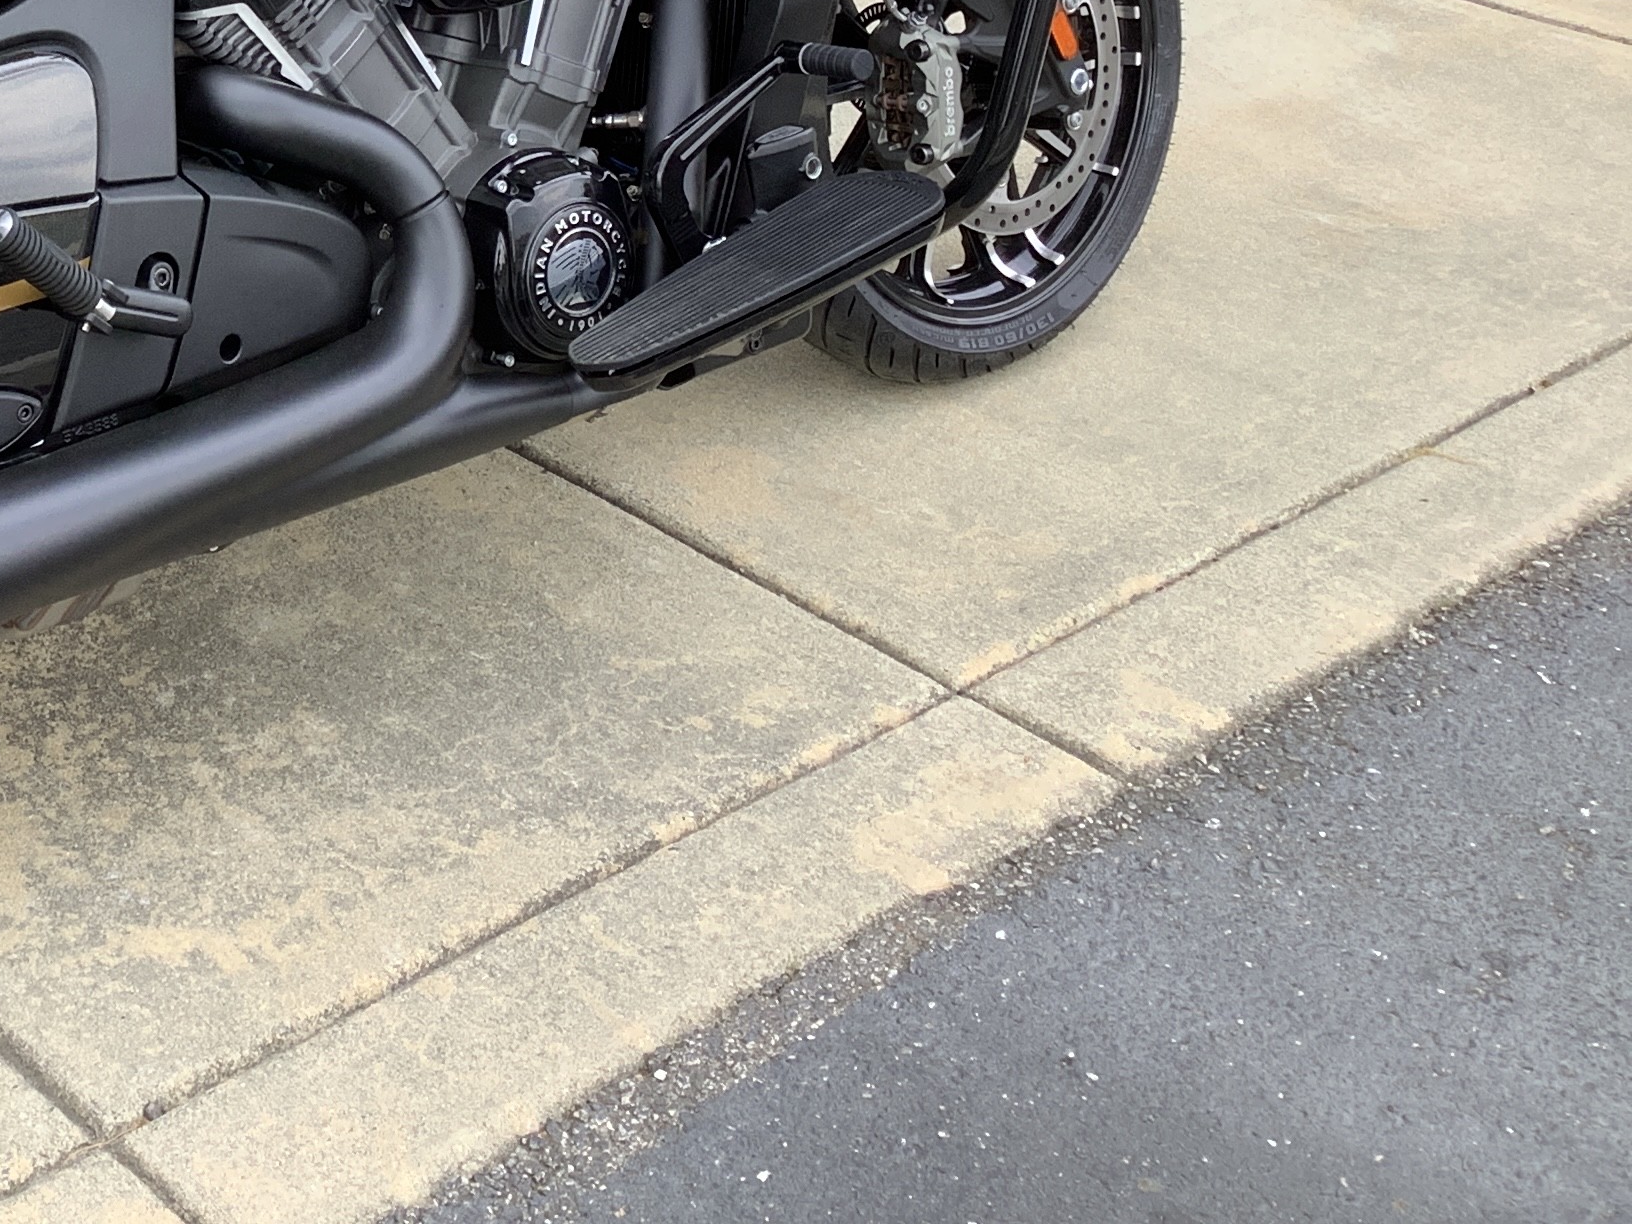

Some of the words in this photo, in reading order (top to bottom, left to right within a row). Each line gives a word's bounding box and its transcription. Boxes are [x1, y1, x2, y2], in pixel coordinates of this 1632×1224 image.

[942, 66, 956, 138] brembo
[534, 237, 556, 320] INDIAN
[554, 209, 628, 297] MOTORCYCLE
